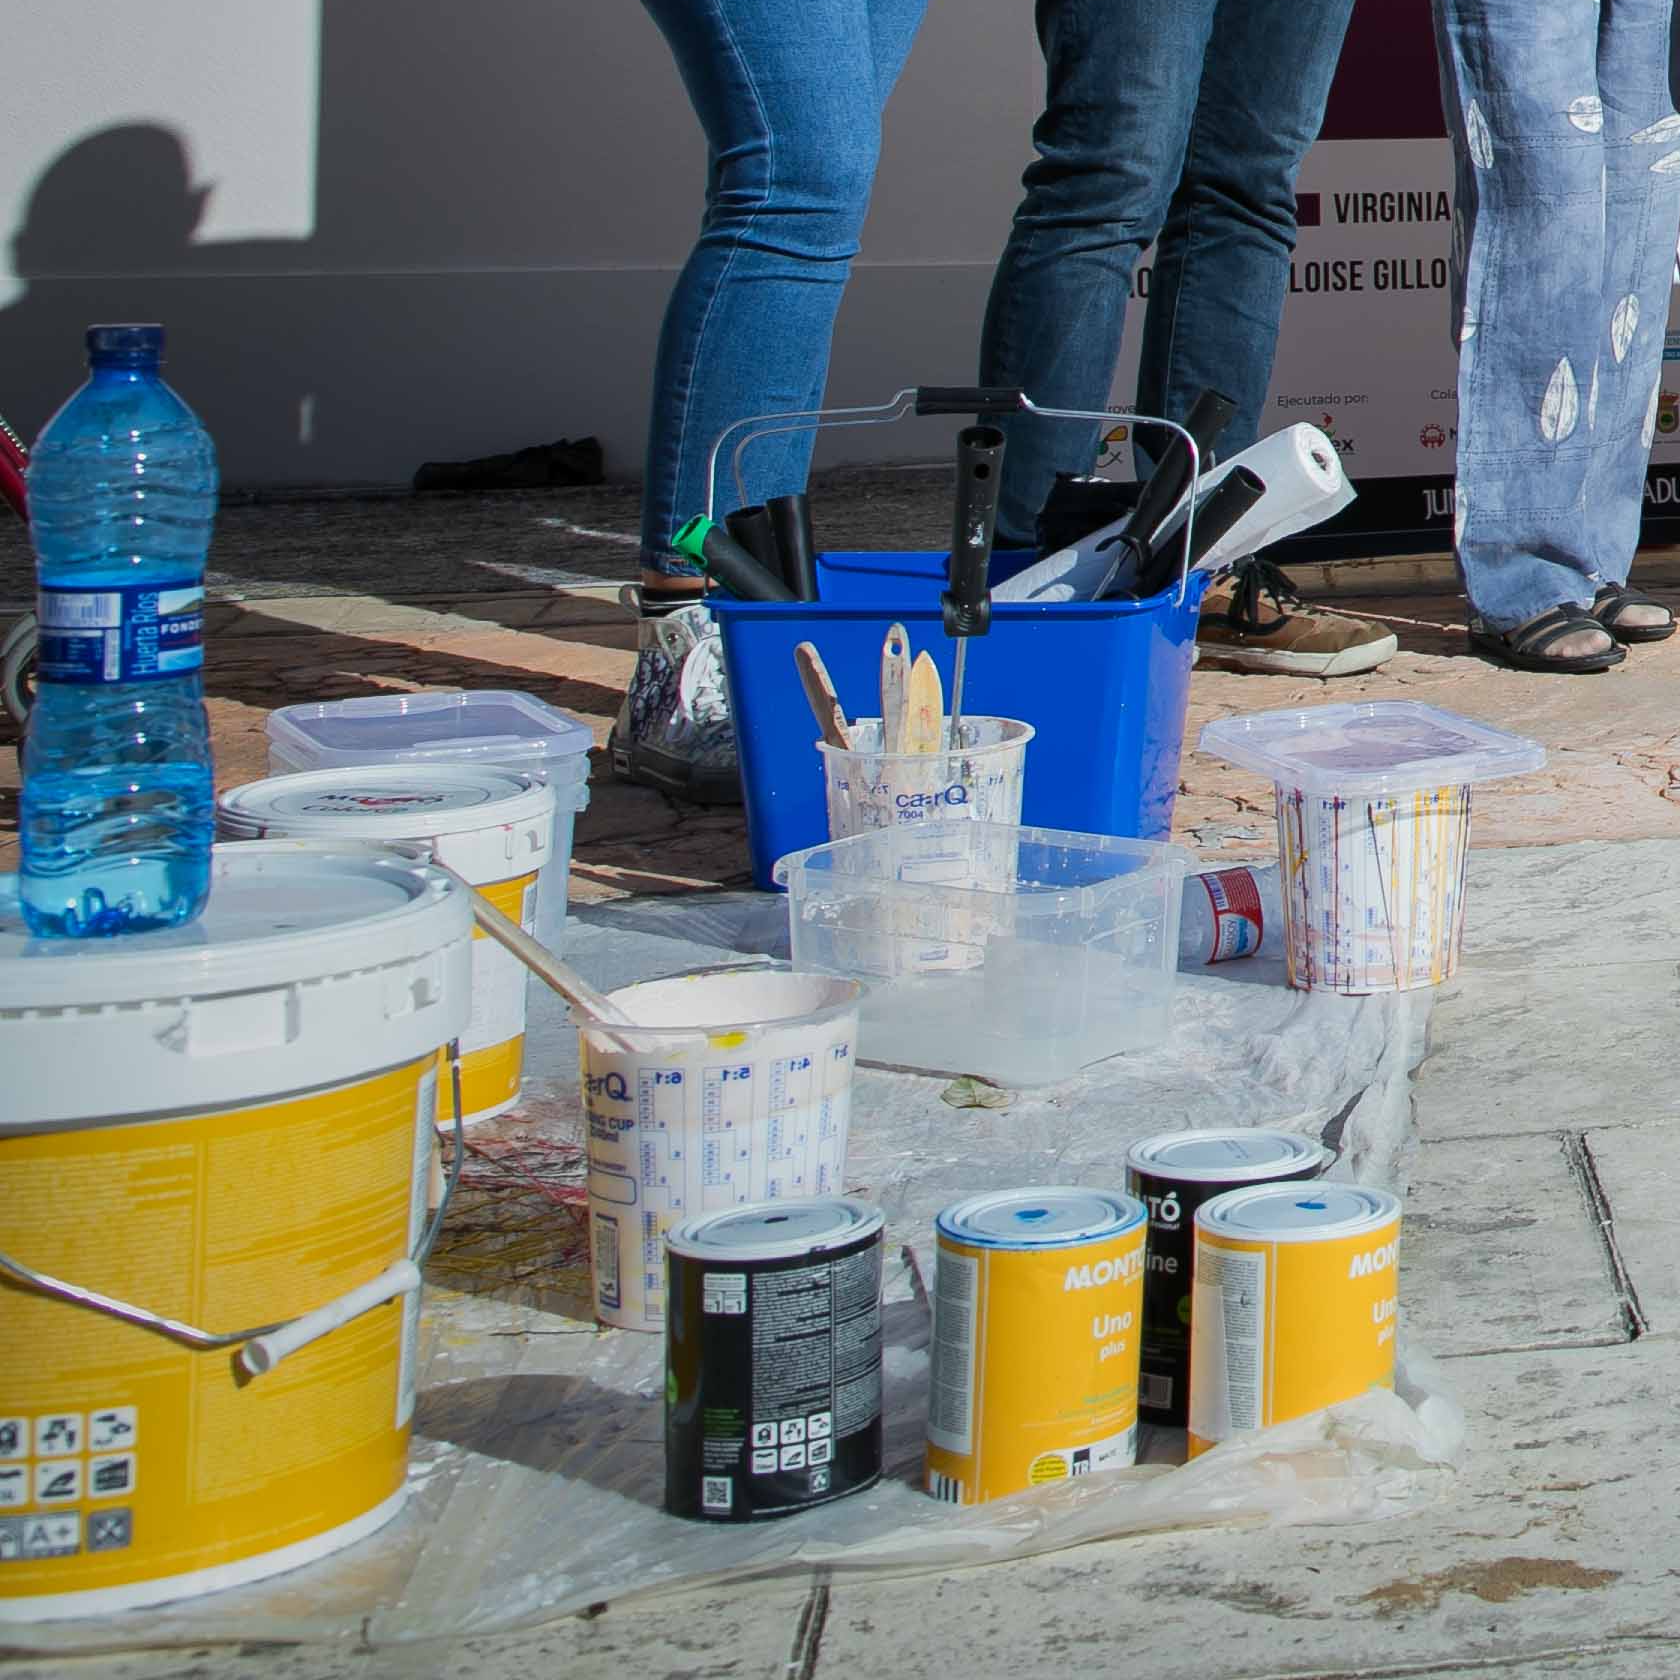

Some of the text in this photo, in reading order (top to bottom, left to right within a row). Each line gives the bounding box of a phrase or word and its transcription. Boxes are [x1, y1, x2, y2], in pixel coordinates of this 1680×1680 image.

[1333, 191, 1452, 224] VIRGINIA
[1277, 392, 1342, 408] Ejecutado
[131, 624, 160, 675] Huerta
[1092, 1309, 1133, 1340] Uno
[1098, 1338, 1127, 1363] plus
